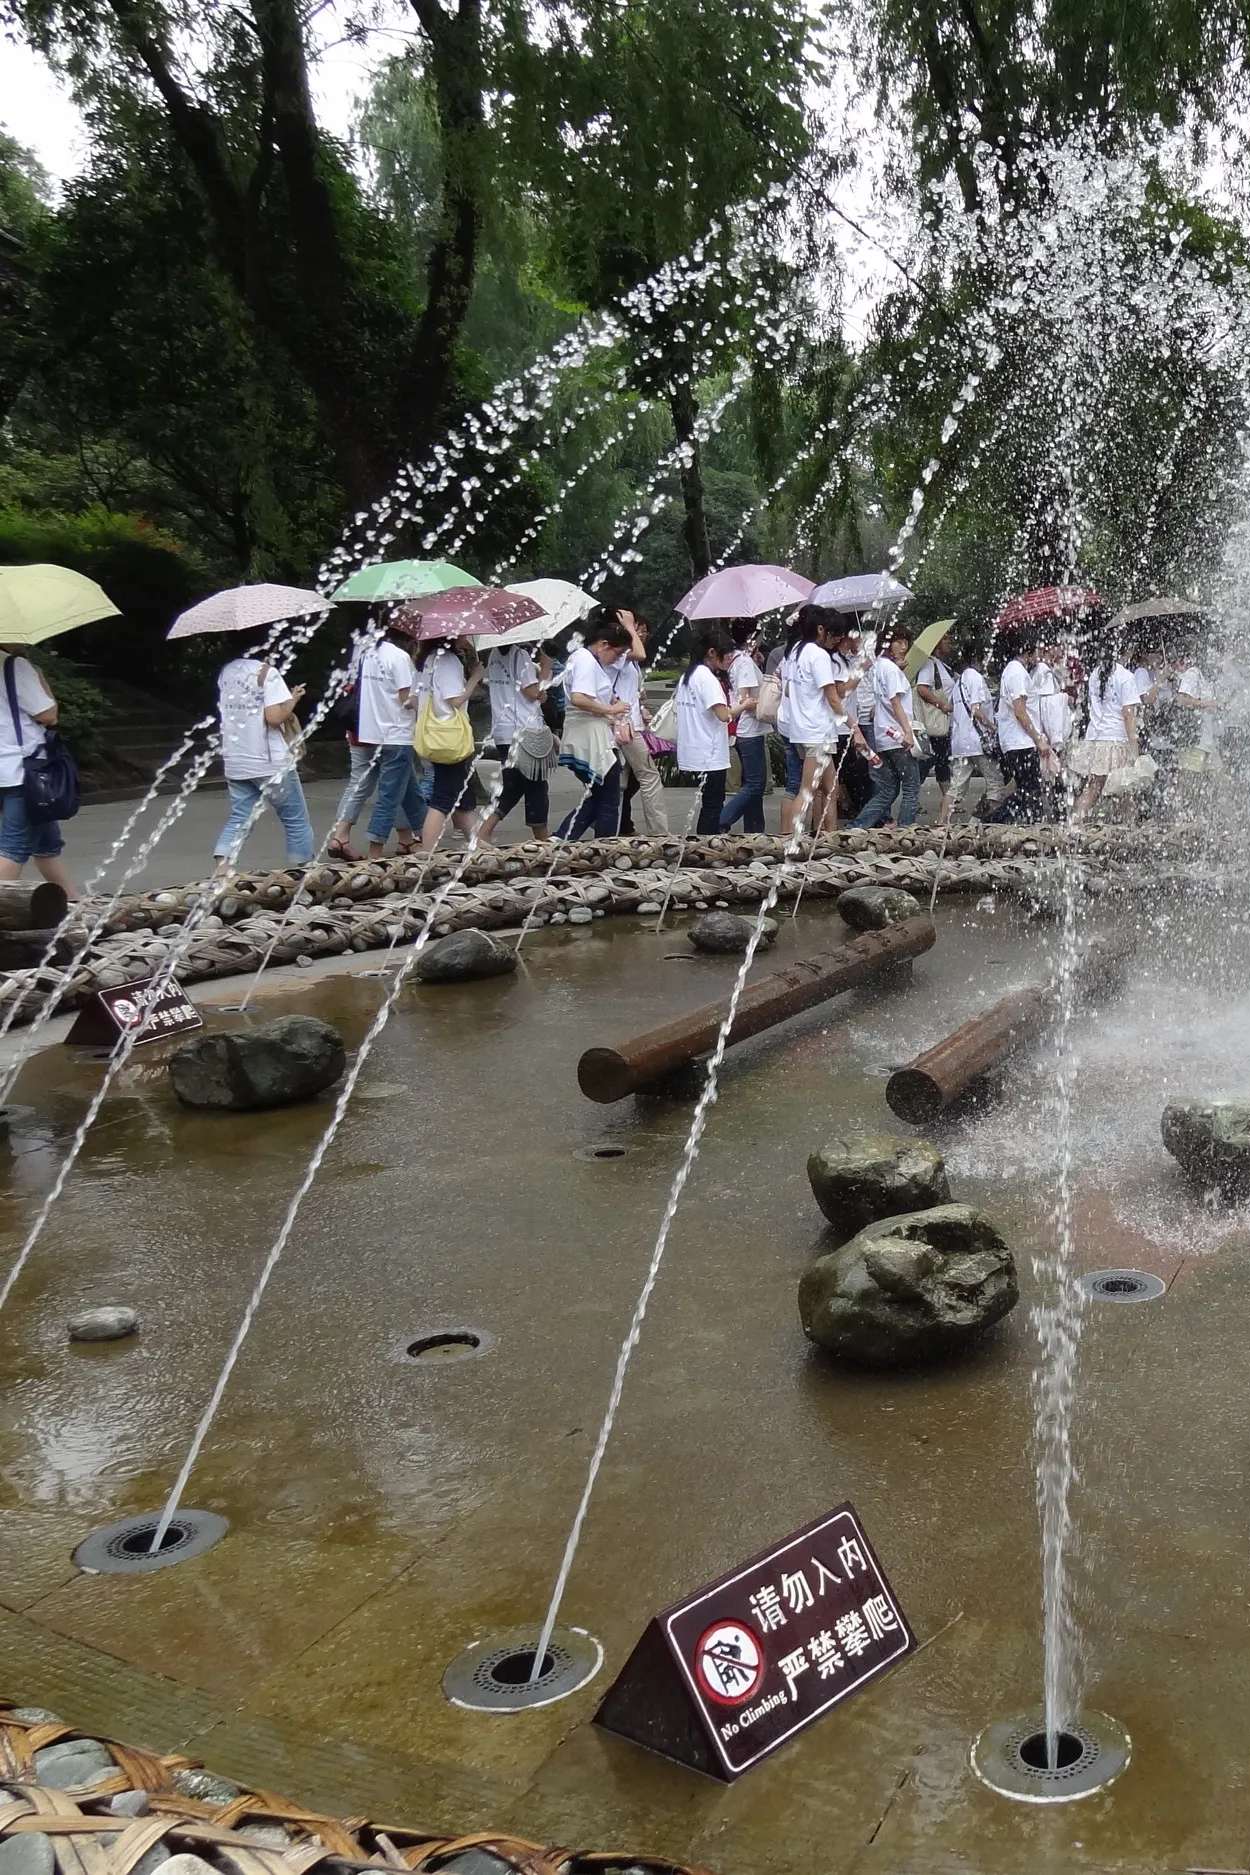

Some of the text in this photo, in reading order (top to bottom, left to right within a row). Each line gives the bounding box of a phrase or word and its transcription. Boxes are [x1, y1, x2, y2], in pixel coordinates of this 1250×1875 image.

[748, 1535, 868, 1634] 请勿入内
[777, 1593, 899, 1702] 严禁攀爬
[720, 1689, 789, 1742] No Climbing
